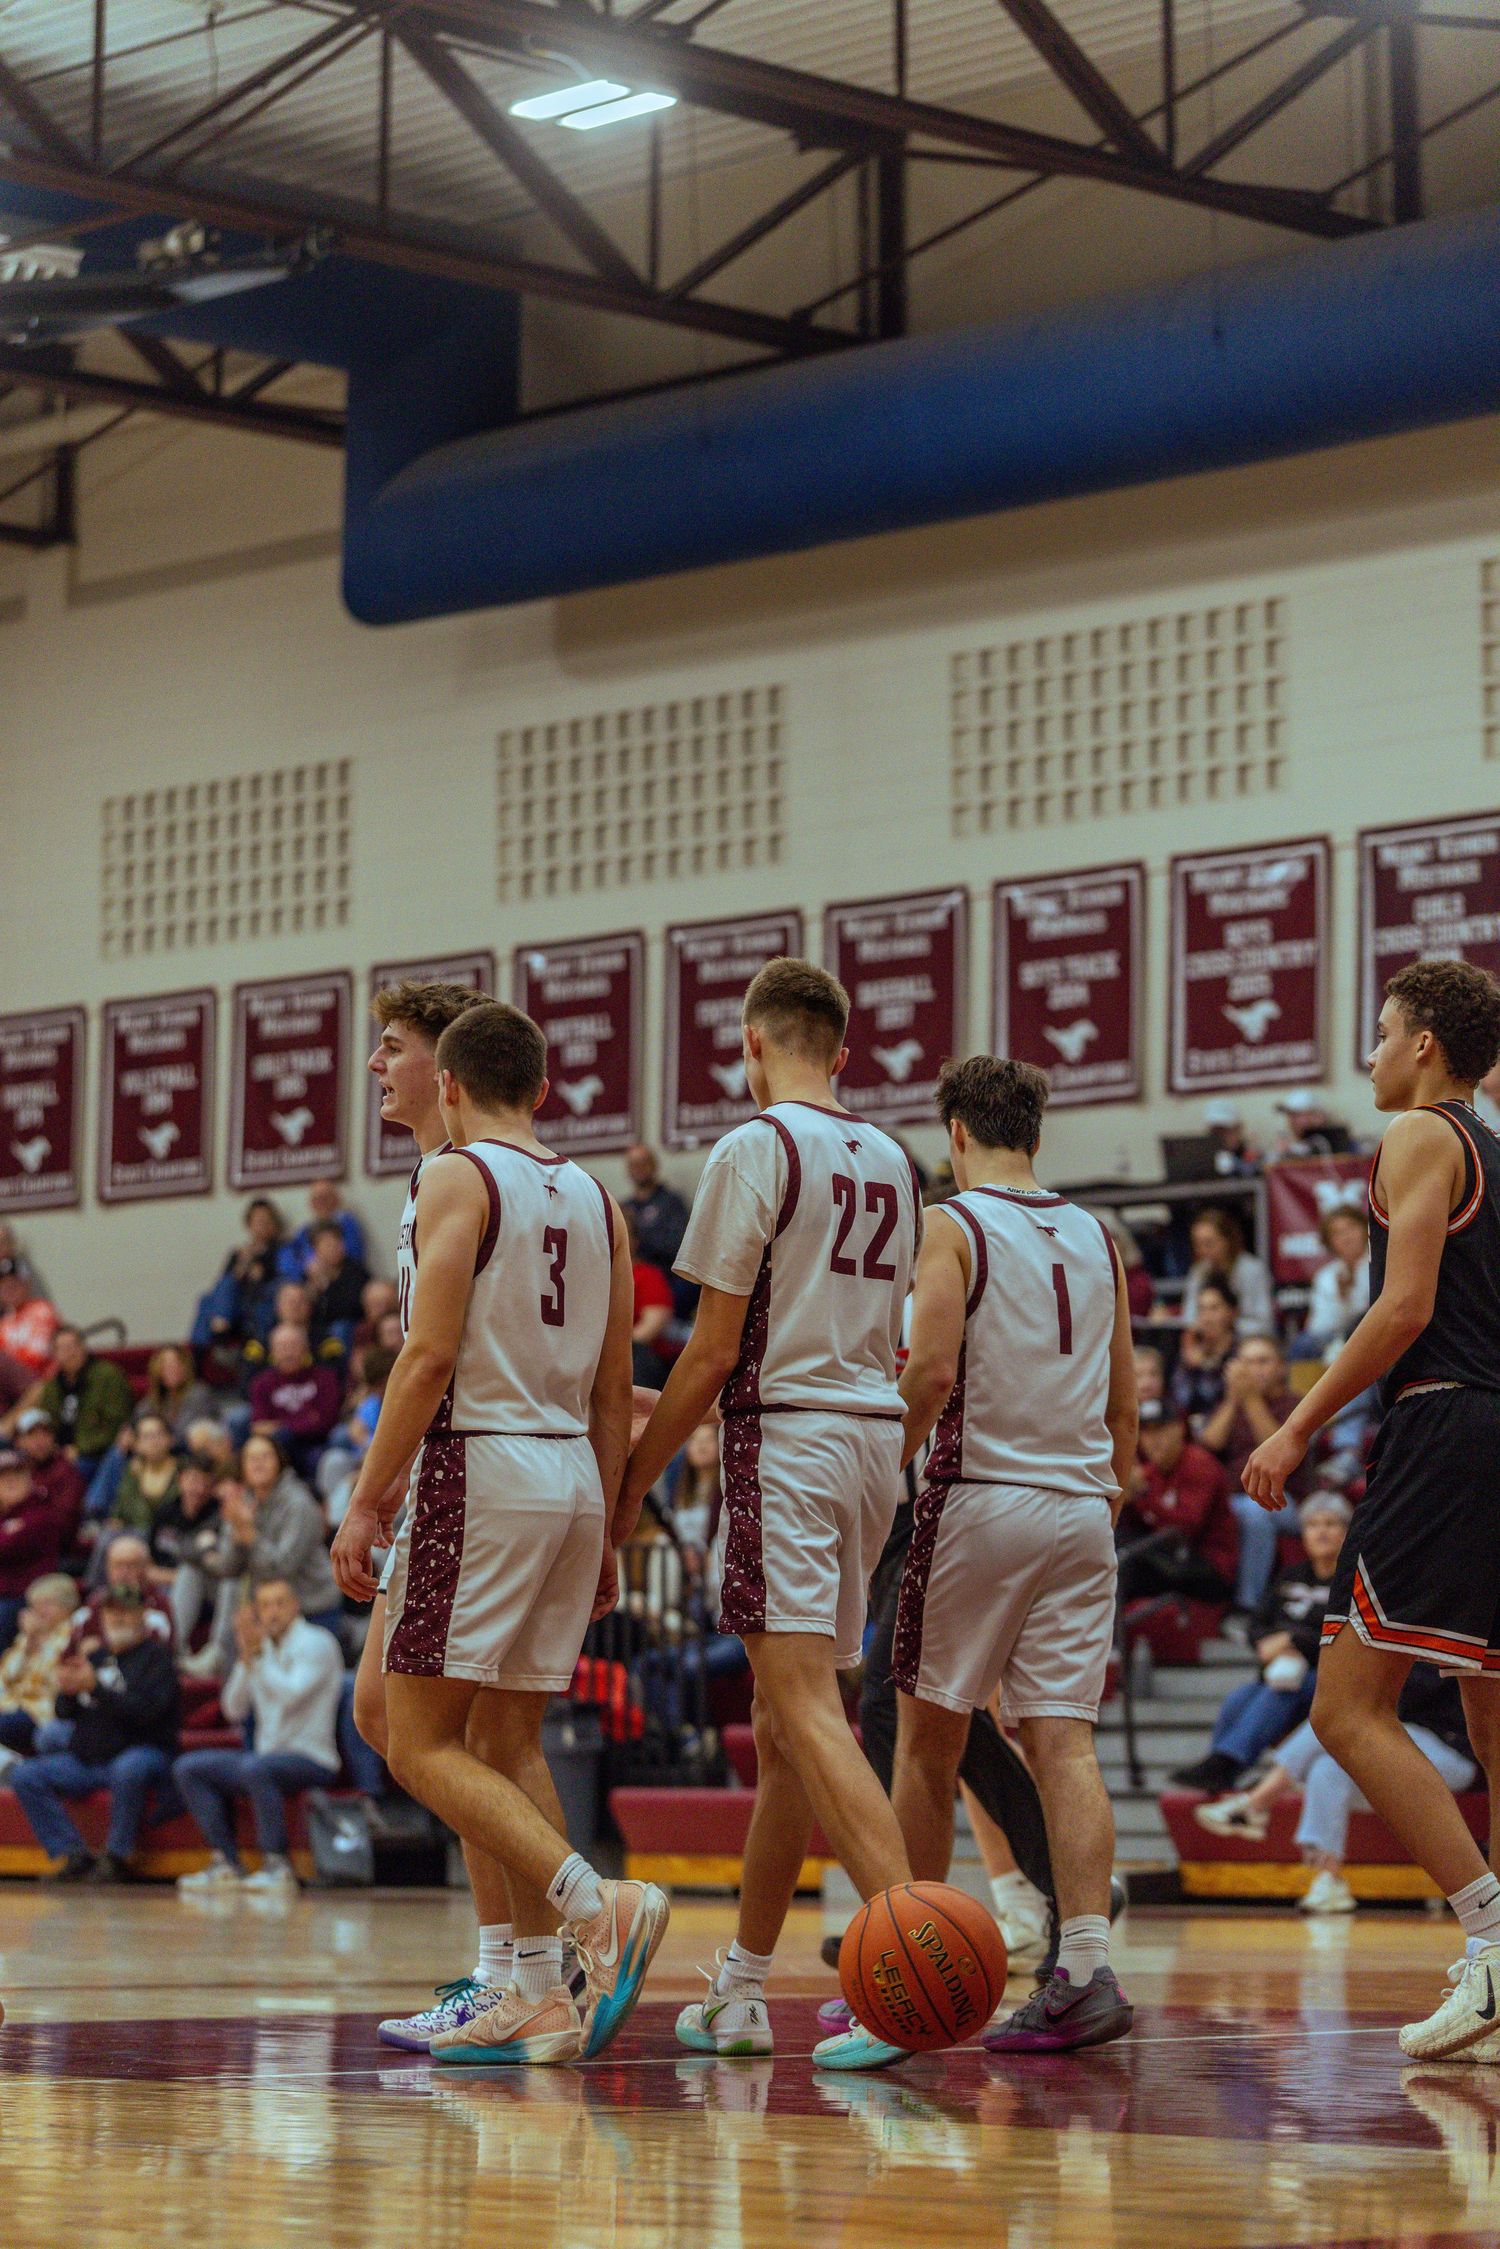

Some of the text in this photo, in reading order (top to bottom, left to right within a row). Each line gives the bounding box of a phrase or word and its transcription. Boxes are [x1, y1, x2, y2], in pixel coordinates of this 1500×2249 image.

[540, 1226, 568, 1327] 3
[830, 1173, 898, 1281] 22
[1052, 1263, 1072, 1355] 1
[880, 1949, 935, 2035] LEGACY
[907, 1920, 979, 2028] SPALDING
